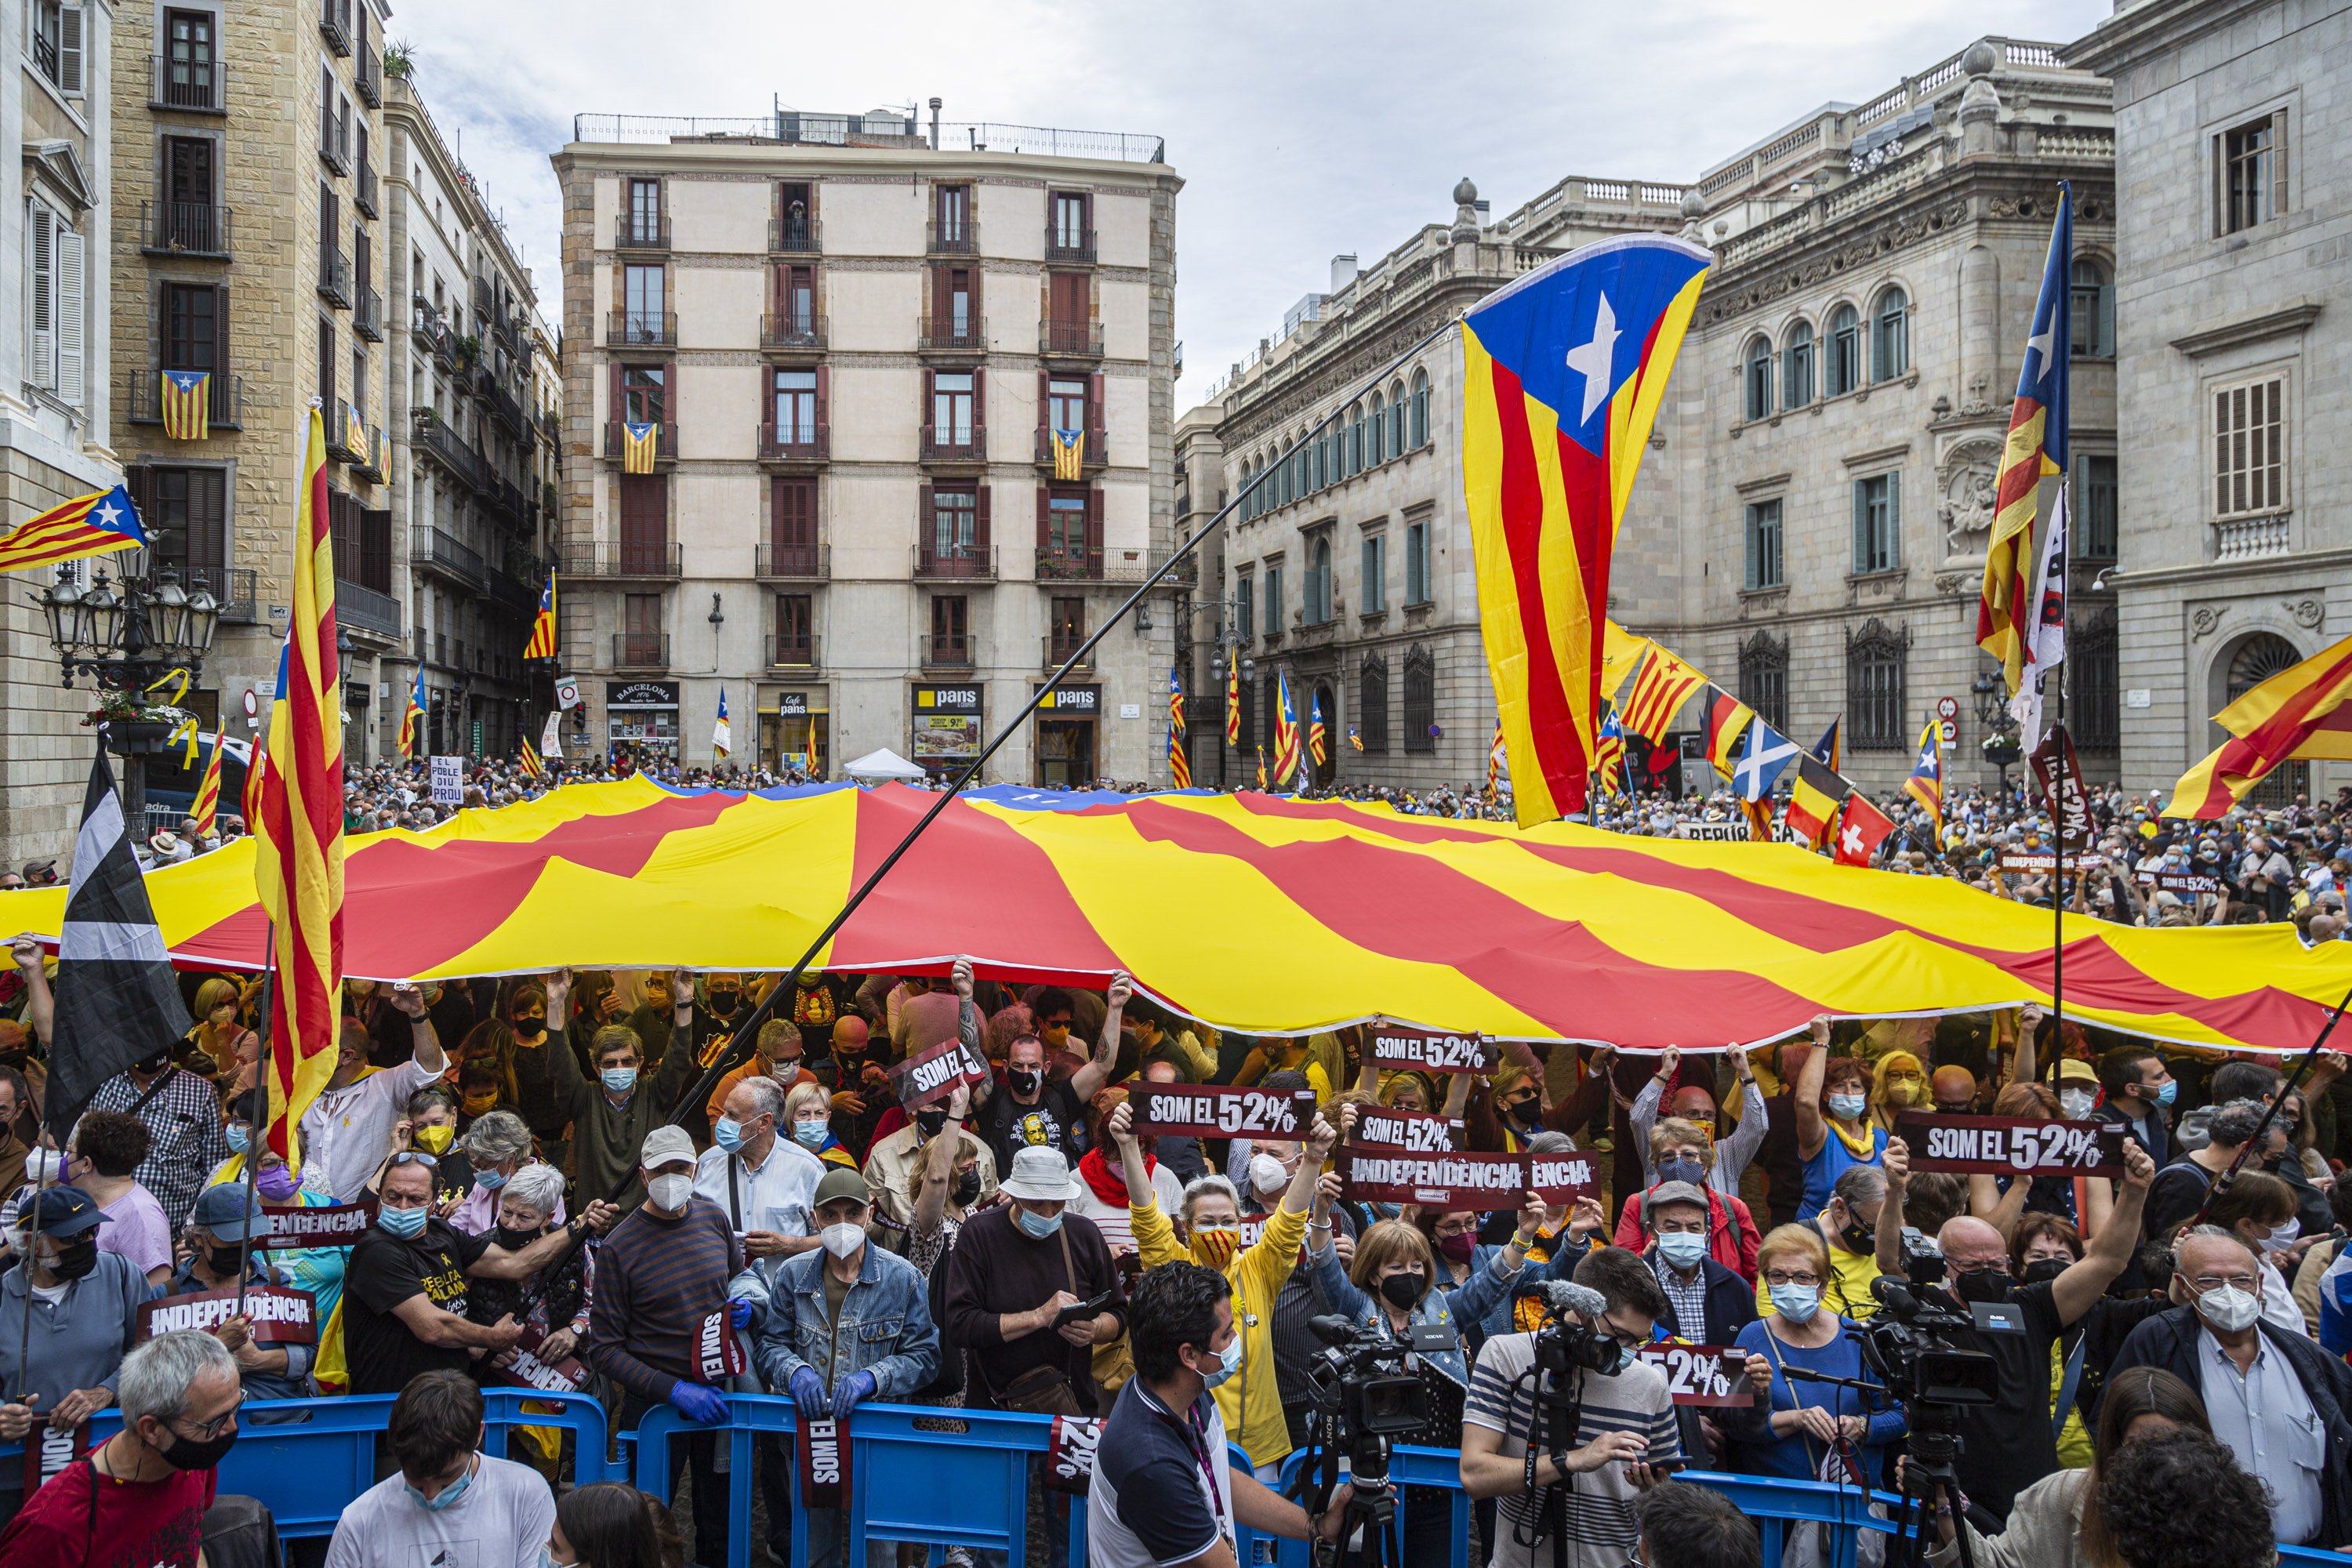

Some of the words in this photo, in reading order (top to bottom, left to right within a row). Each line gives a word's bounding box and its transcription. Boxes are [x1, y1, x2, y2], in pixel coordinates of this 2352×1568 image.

[616, 684, 670, 701] BARCELONA
[785, 695, 800, 706] Cafe
[937, 690, 976, 707] pans
[1057, 691, 1094, 707] pans
[781, 705, 806, 716] pans
[432, 767, 459, 776] POBLE
[434, 788, 461, 800] PROU
[2161, 877, 2177, 887] SOM
[2178, 877, 2187, 887] EL
[2187, 877, 2218, 891] 52%
[1375, 1036, 1406, 1058] SOM
[1407, 1040, 1424, 1060] EL
[1425, 1036, 1486, 1069] 52%
[912, 1056, 951, 1091] SOM
[946, 1050, 964, 1077] EL
[1149, 1094, 1192, 1123] SOM
[1194, 1097, 1215, 1124] EL
[1218, 1092, 1298, 1133] 52%
[1362, 1116, 1392, 1143] SOM
[1391, 1120, 1405, 1145] EL
[1405, 1117, 1453, 1152] 52%
[1927, 1127, 1978, 1160] SOM
[1981, 1131, 2007, 1160] EL
[2010, 1124, 2103, 1169] 52%
[1351, 1158, 1523, 1189] INDEPENDÈNCIA
[267, 1210, 367, 1235] ENDÈNCIA
[701, 1312, 722, 1358] SOM
[702, 1358, 725, 1381] EL
[810, 1415, 836, 1437] EL
[42, 1426, 75, 1472] SOM
[811, 1442, 840, 1483] SOM
[1526, 1450, 1535, 1487] SONY
